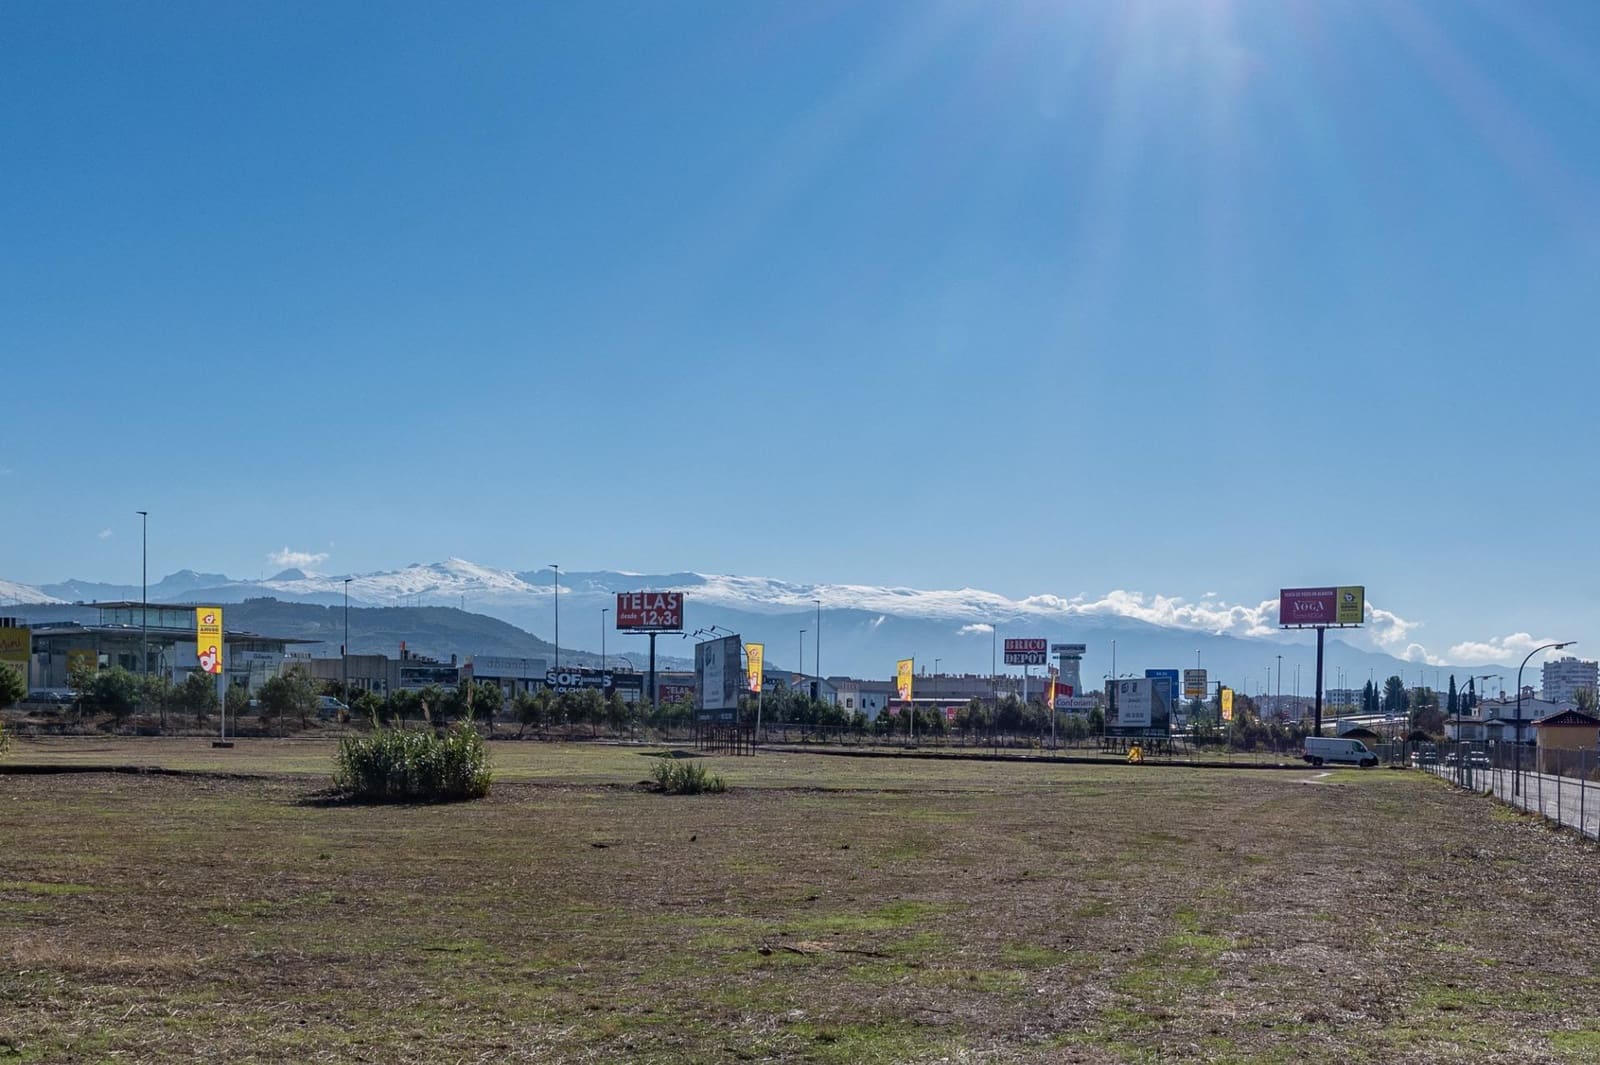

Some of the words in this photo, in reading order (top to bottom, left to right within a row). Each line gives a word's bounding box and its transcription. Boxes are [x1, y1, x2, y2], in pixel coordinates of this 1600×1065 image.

[619, 594, 678, 610] TELAS
[1293, 600, 1325, 612] NOGA
[1005, 639, 1046, 650] BRICO
